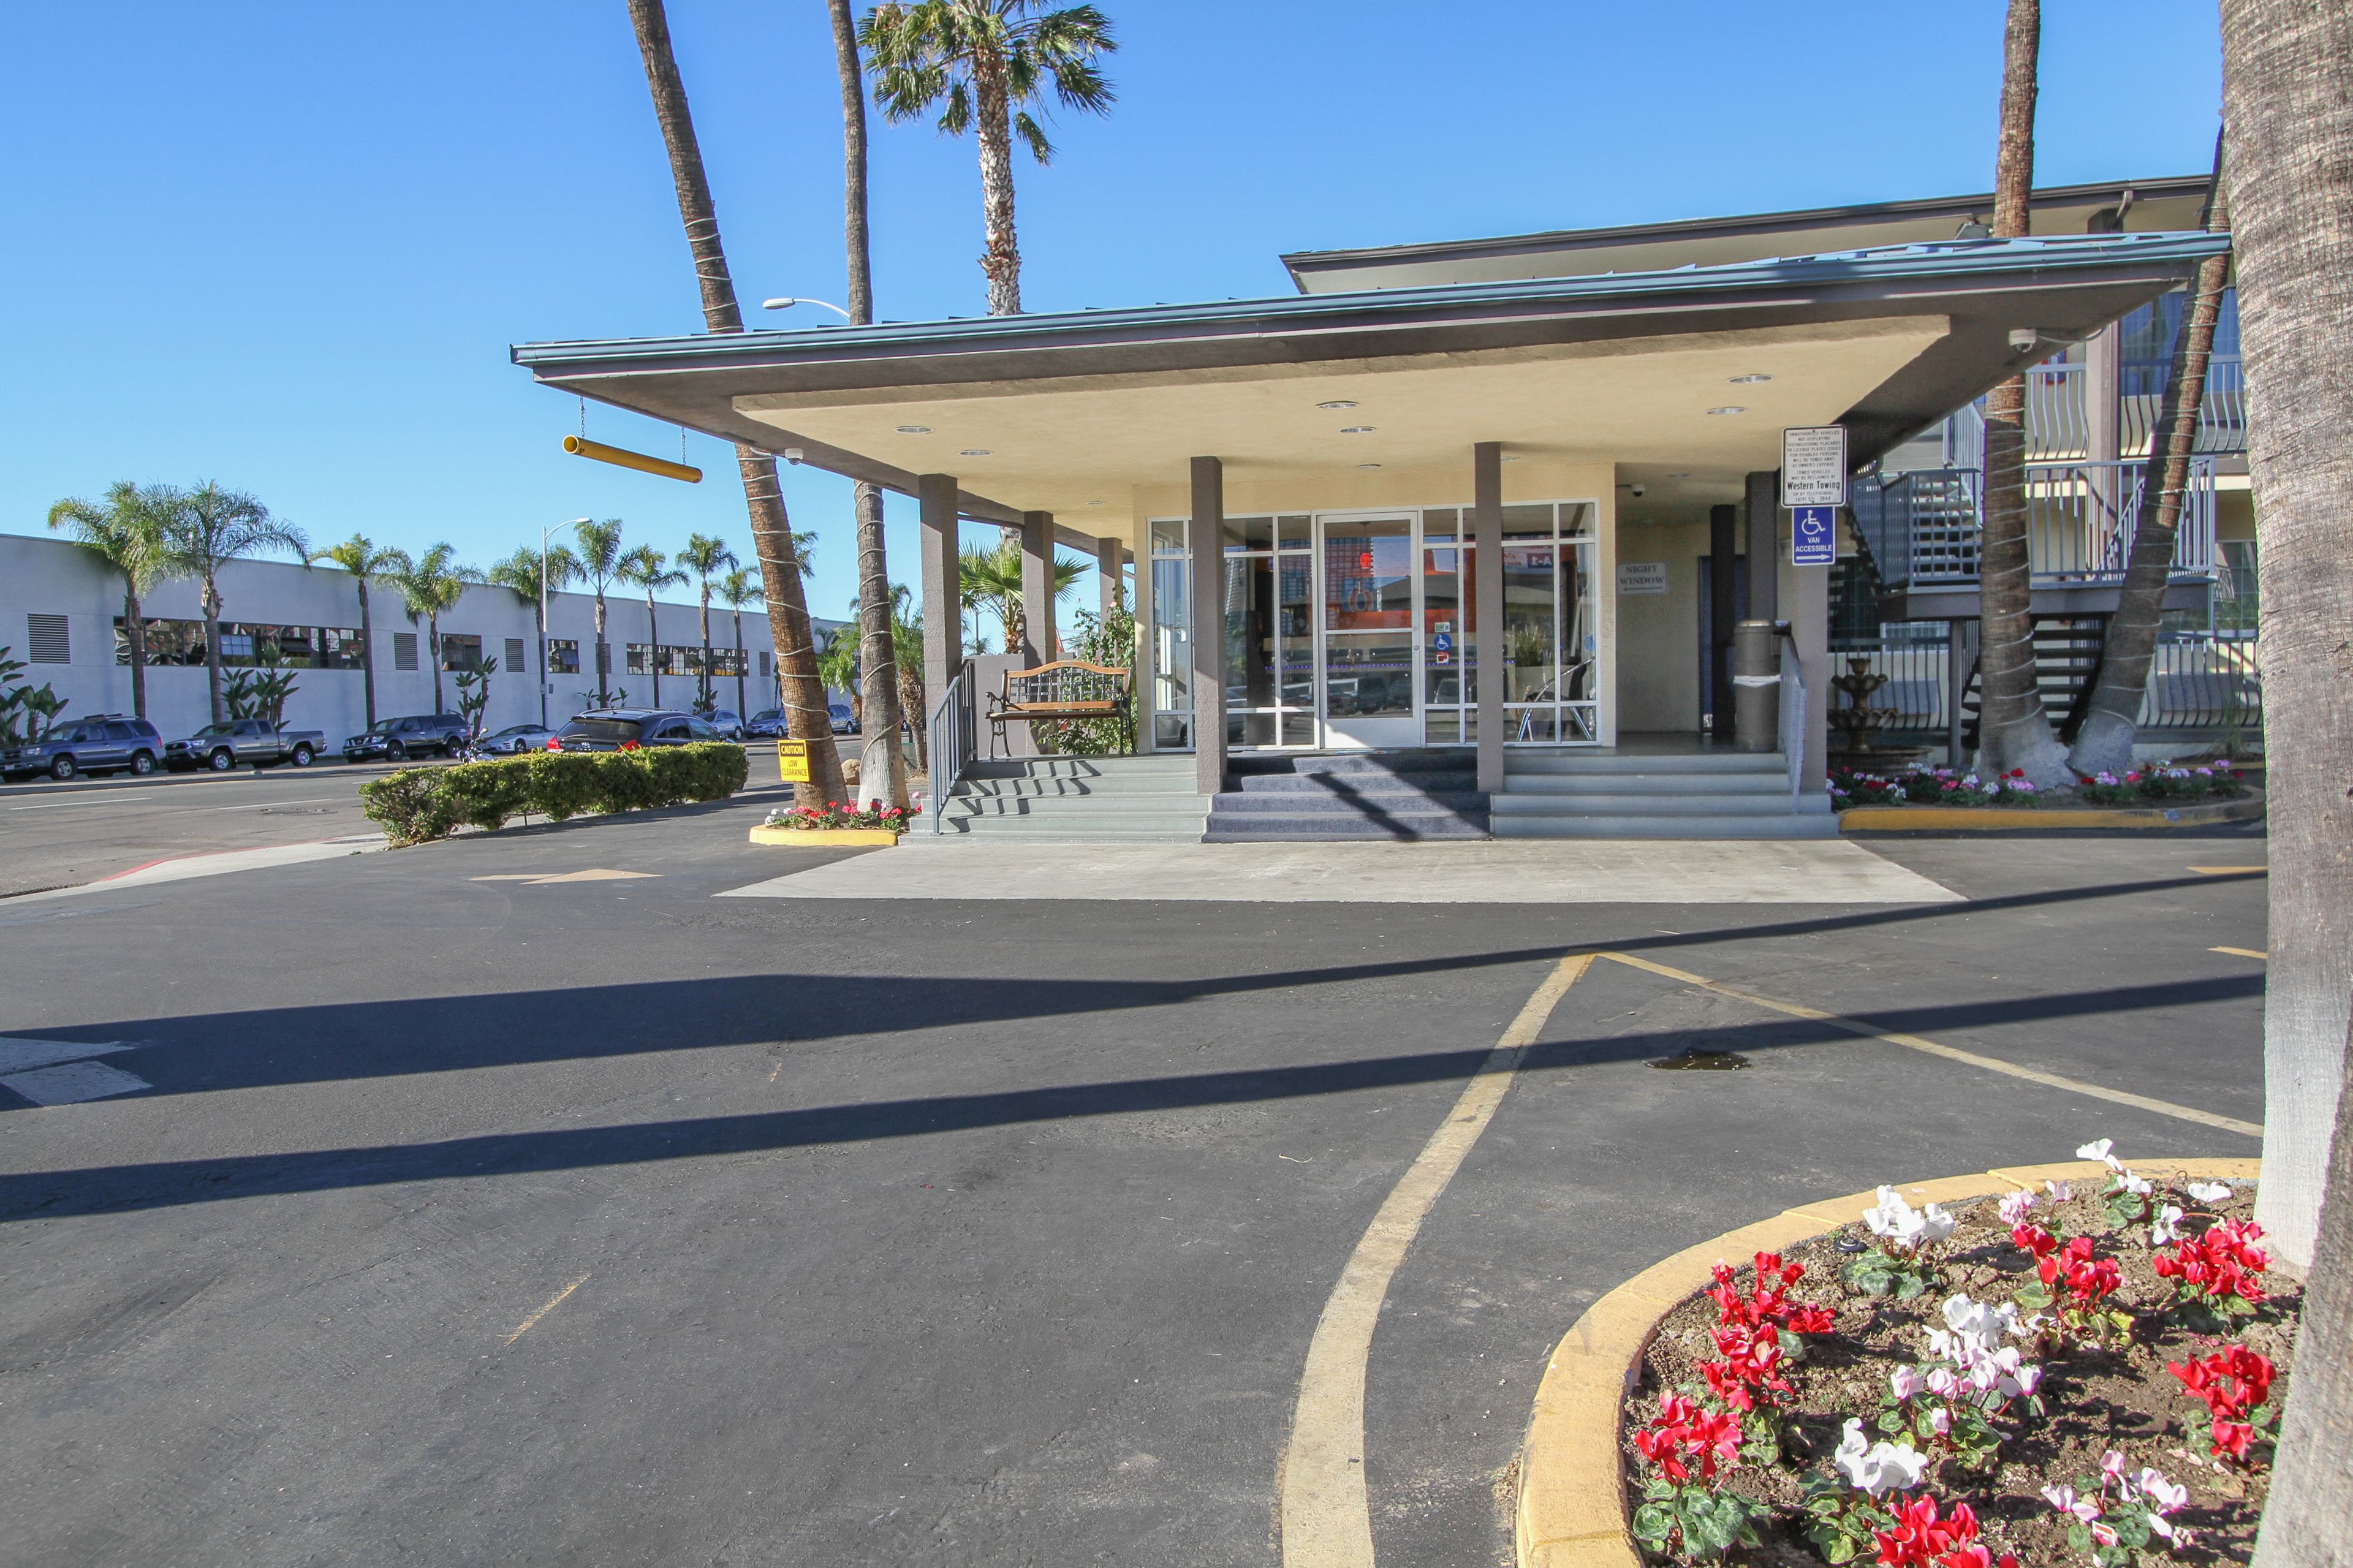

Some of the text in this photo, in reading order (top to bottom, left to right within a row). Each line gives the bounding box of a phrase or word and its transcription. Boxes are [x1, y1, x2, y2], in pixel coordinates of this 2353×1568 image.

[1787, 480, 1840, 490] Western Towing
[1626, 565, 1657, 574] NIGHT
[781, 745, 803, 754] CAUTION
